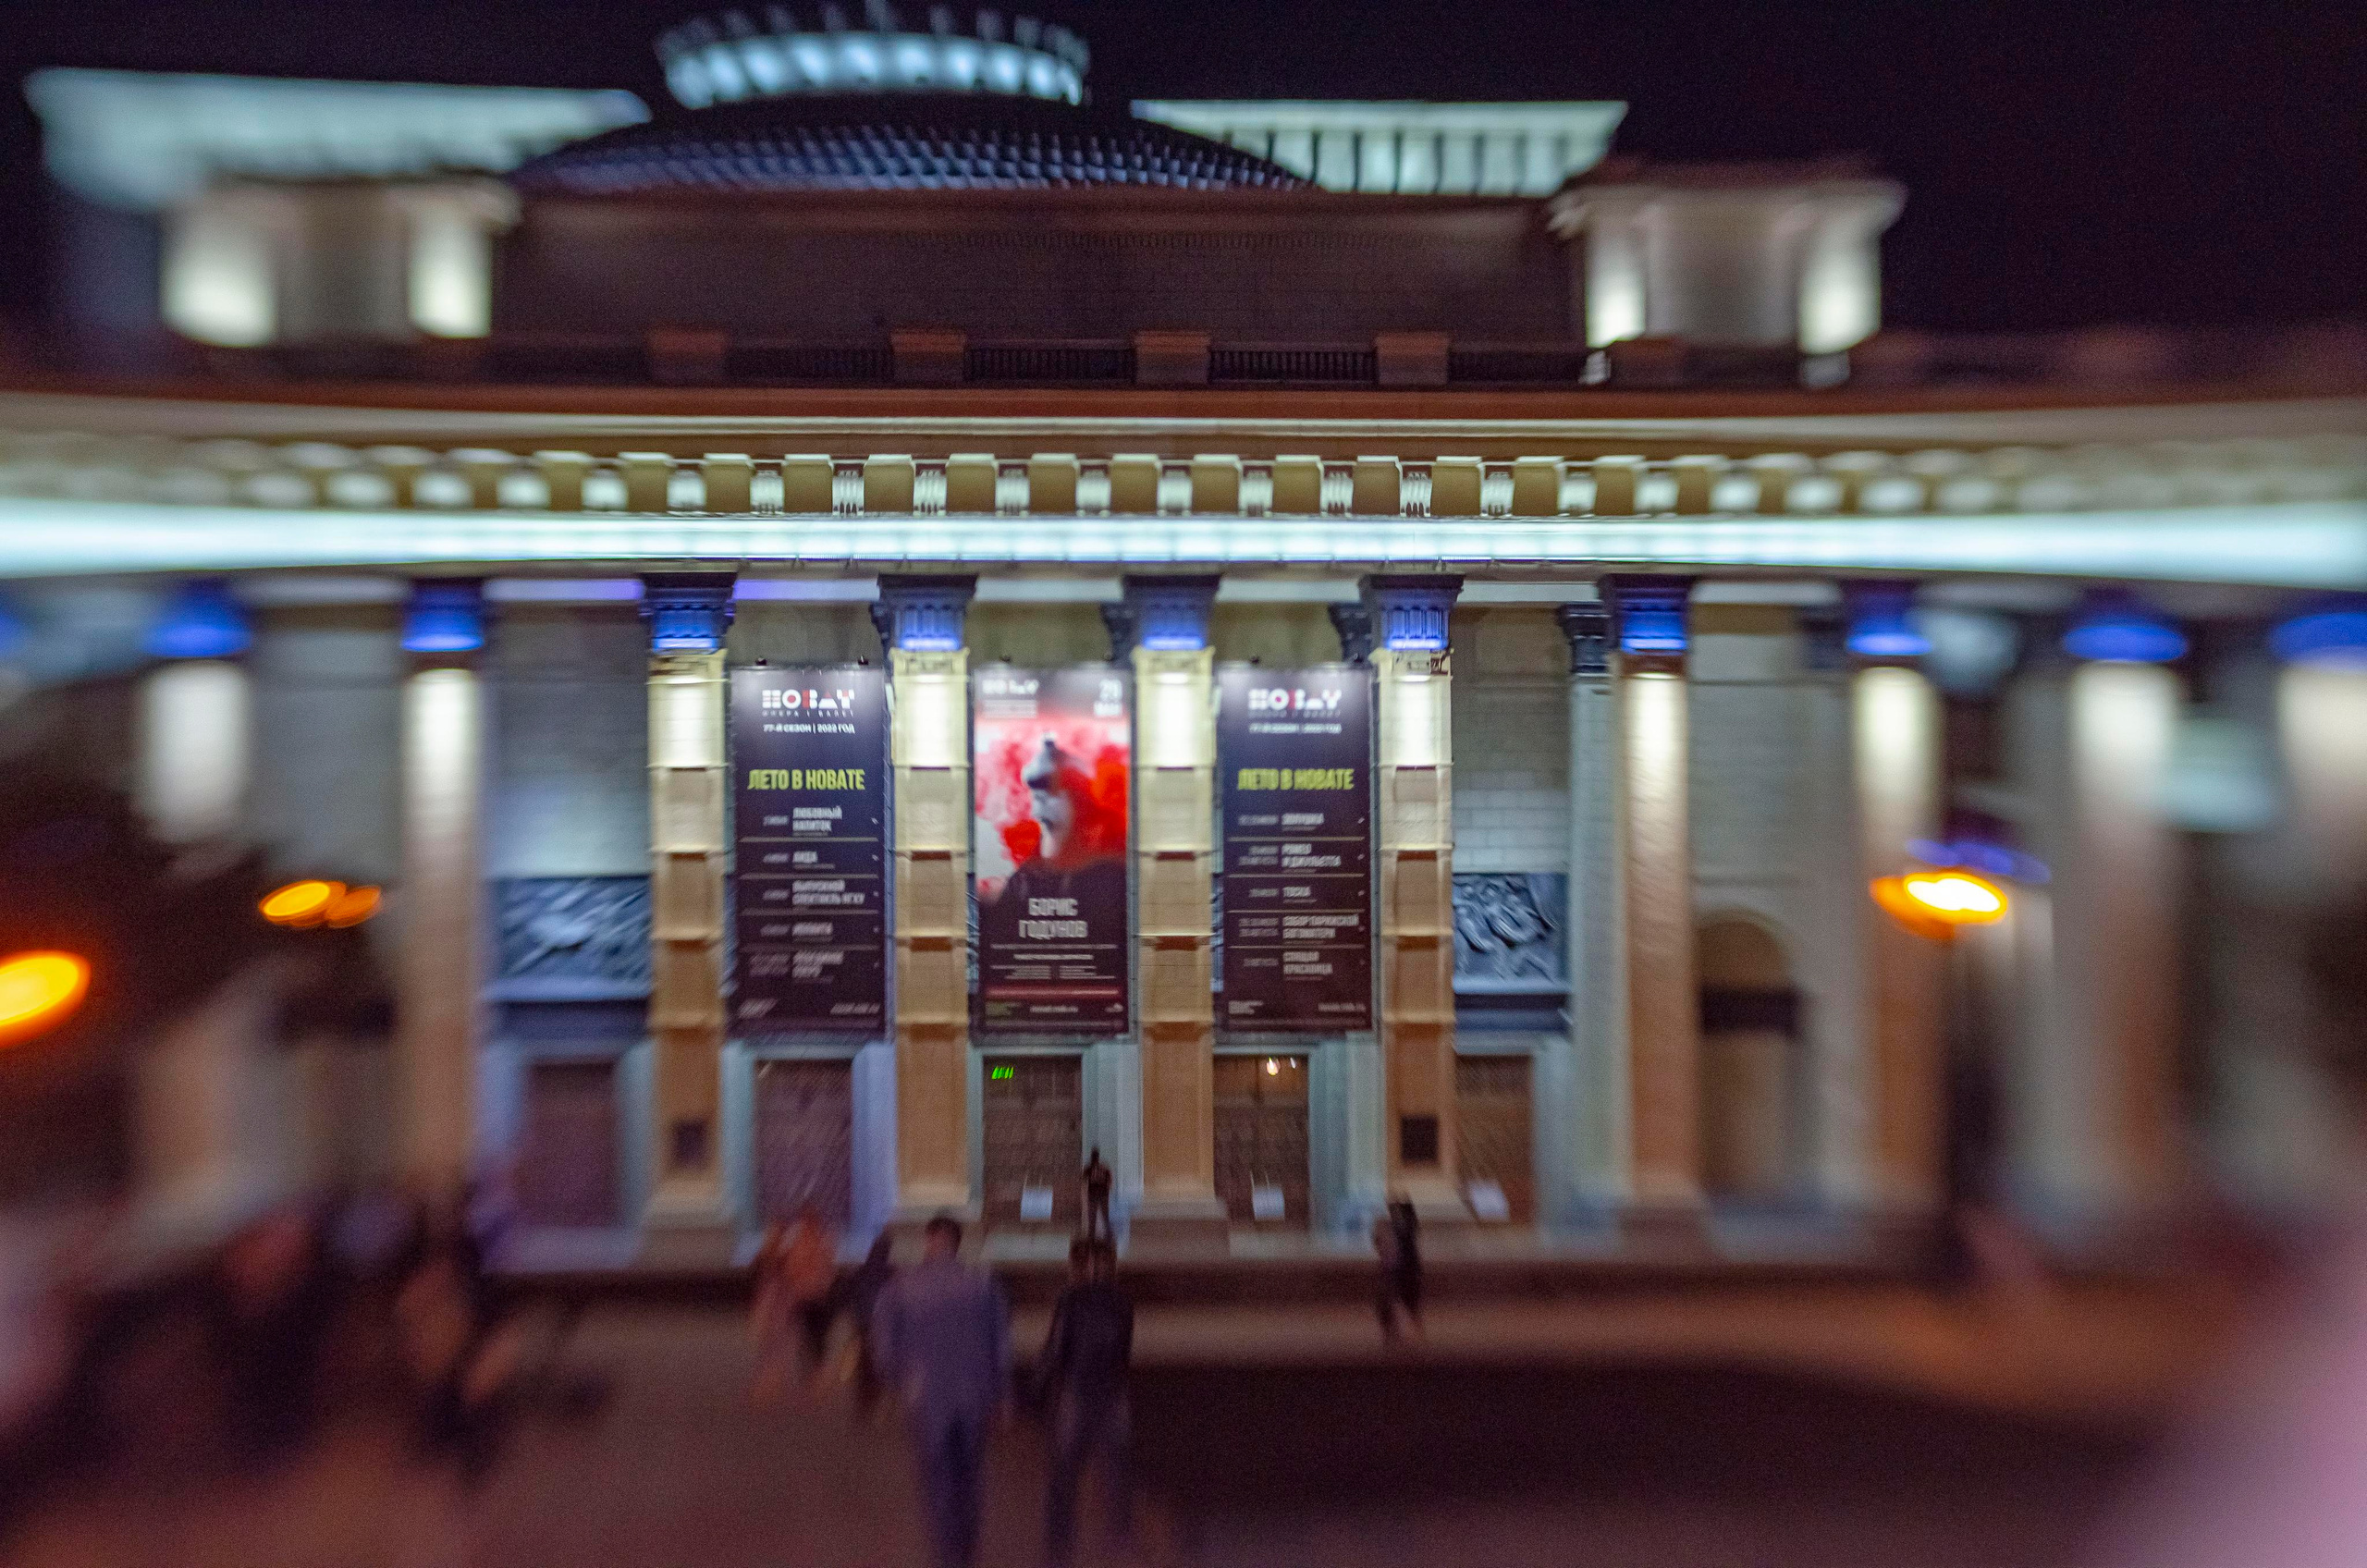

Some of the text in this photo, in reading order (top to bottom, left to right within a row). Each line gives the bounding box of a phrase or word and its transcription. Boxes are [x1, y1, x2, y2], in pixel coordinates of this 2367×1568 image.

[762, 689, 854, 709] НОВАТ
[747, 769, 865, 790] ЛЕТО В НОВАТЕ
[1238, 768, 1354, 790] ЛЕТО В НОВАТЕ
[1028, 898, 1078, 916] БОРИС
[1019, 920, 1088, 939] ГОДУНОВ
